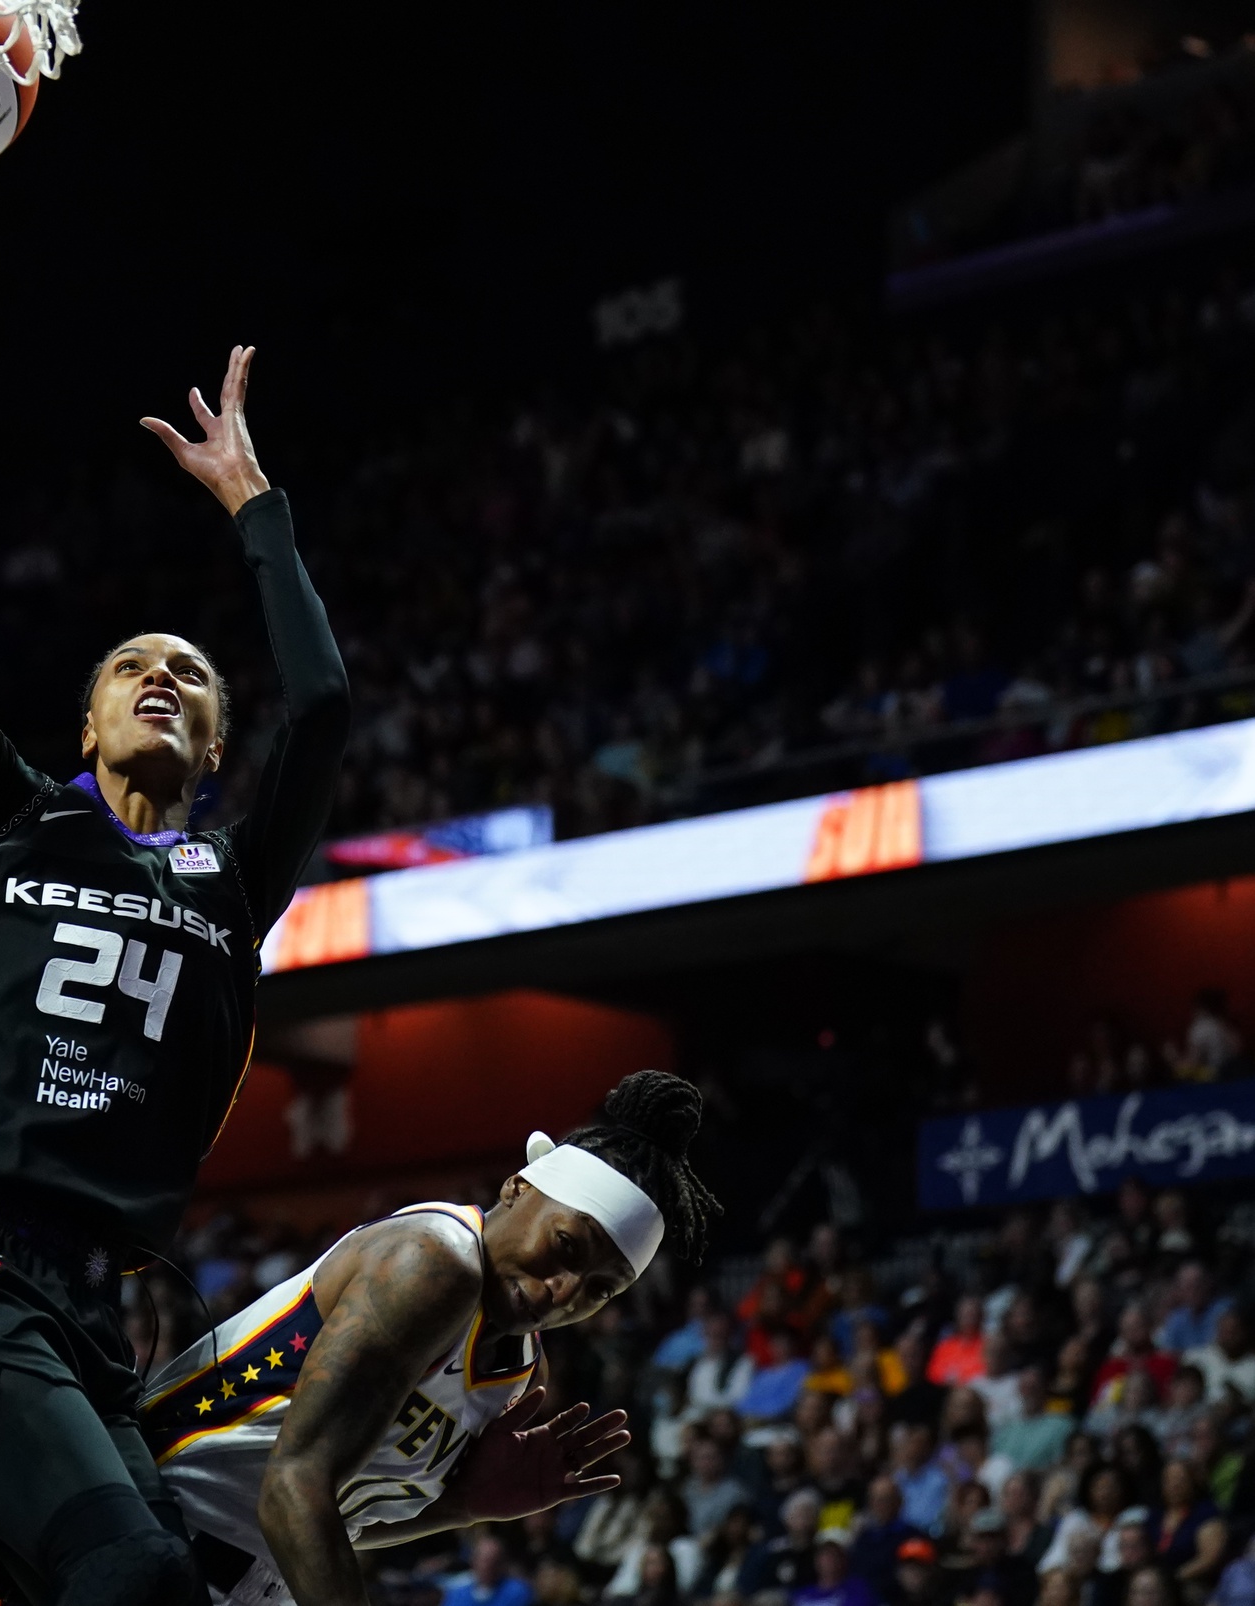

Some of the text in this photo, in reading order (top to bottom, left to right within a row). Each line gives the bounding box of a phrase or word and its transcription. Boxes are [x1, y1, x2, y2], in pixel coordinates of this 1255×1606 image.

[175, 858, 212, 867] Post
[5, 877, 232, 957] KEESUSK
[36, 922, 183, 1042] 24
[46, 1035, 88, 1062] Yale
[36, 1081, 112, 1113] Health
[41, 1057, 146, 1104] NewHaven
